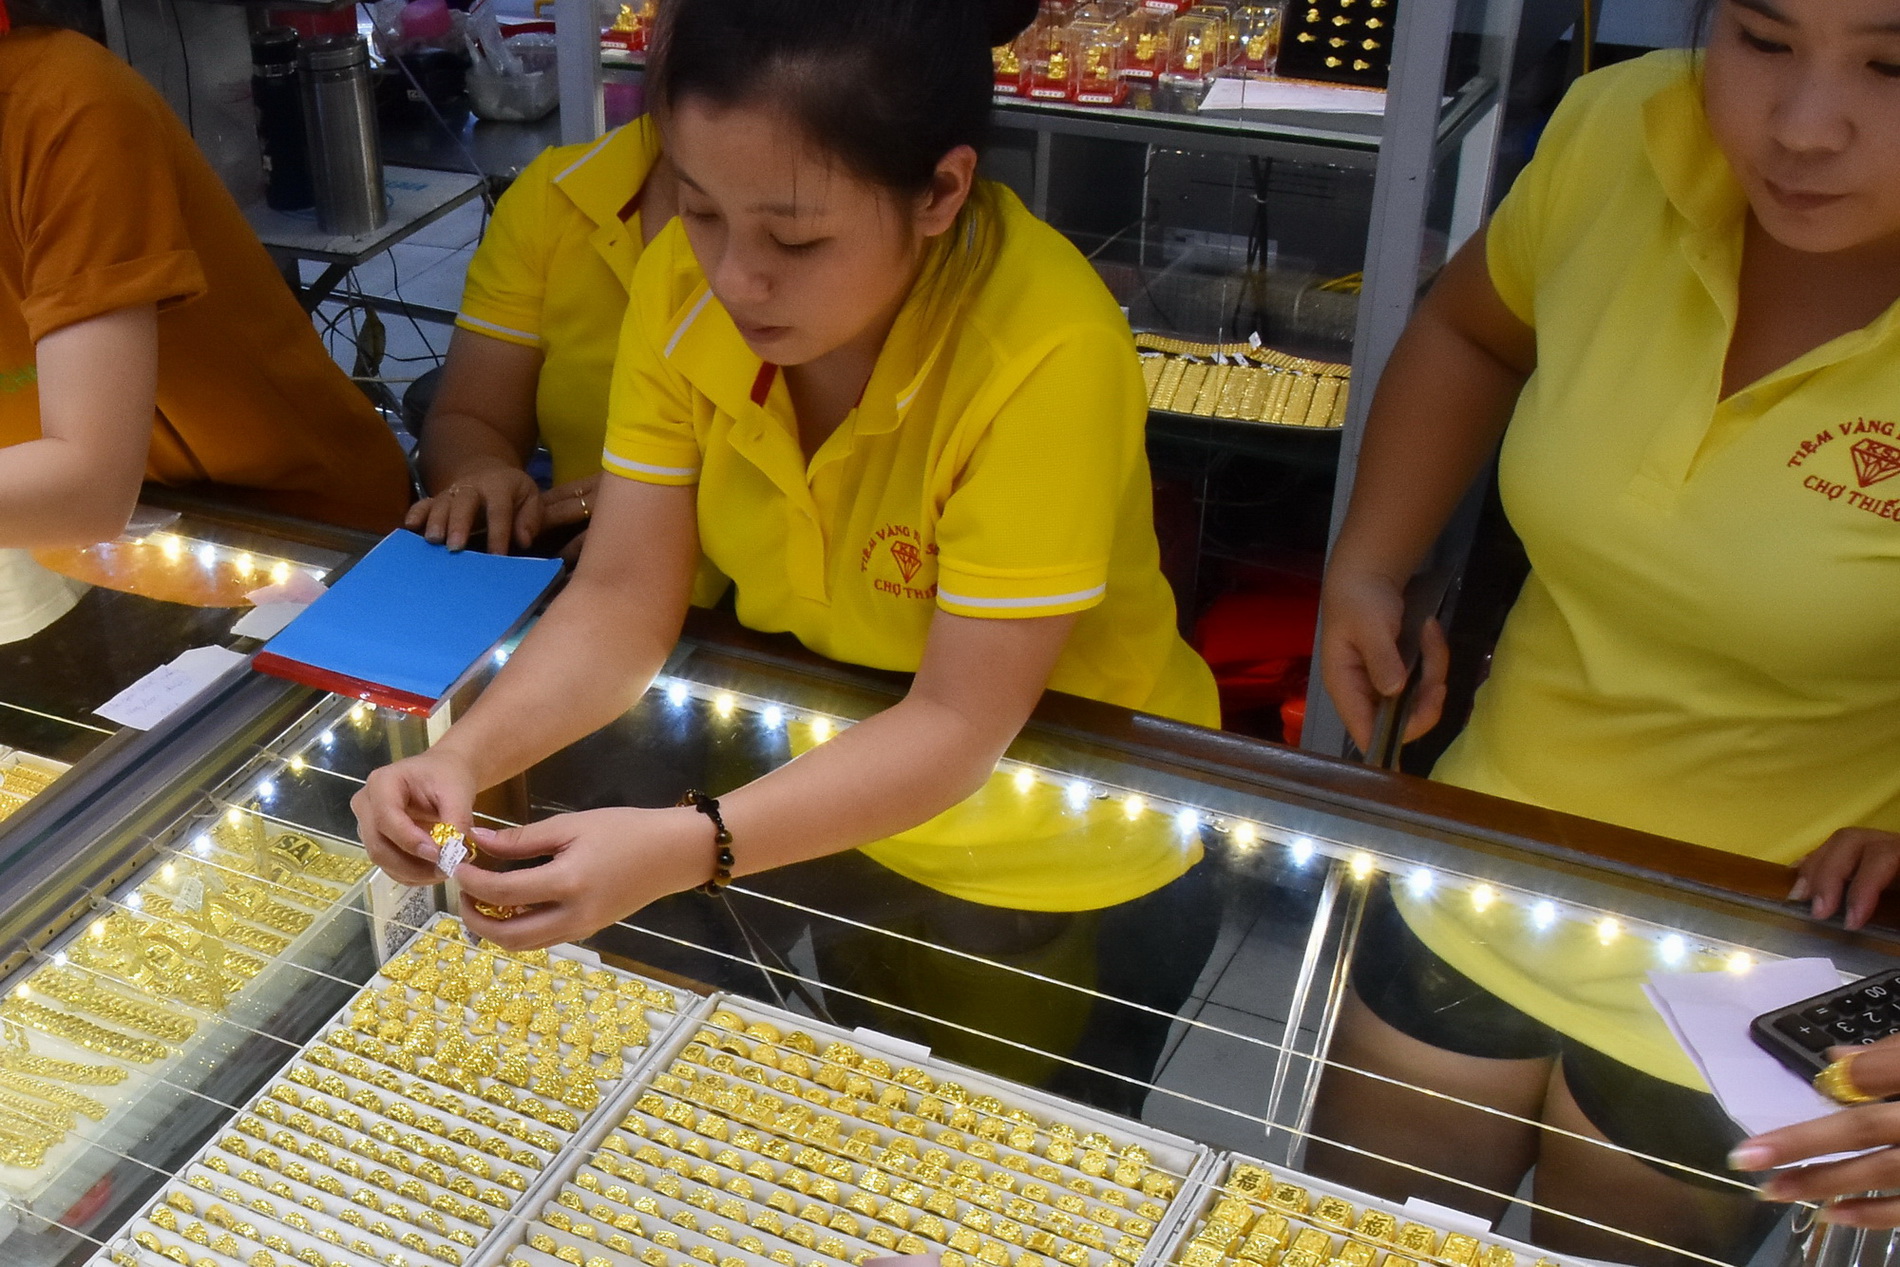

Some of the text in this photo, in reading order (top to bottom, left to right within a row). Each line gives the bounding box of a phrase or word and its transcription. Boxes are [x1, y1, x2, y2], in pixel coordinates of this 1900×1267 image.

[1787, 416, 1895, 467] TIỆM VÀNG
[1803, 475, 1847, 501] CHỢ
[1862, 1011, 1882, 1023] 2
[1836, 1021, 1856, 1033] 3
